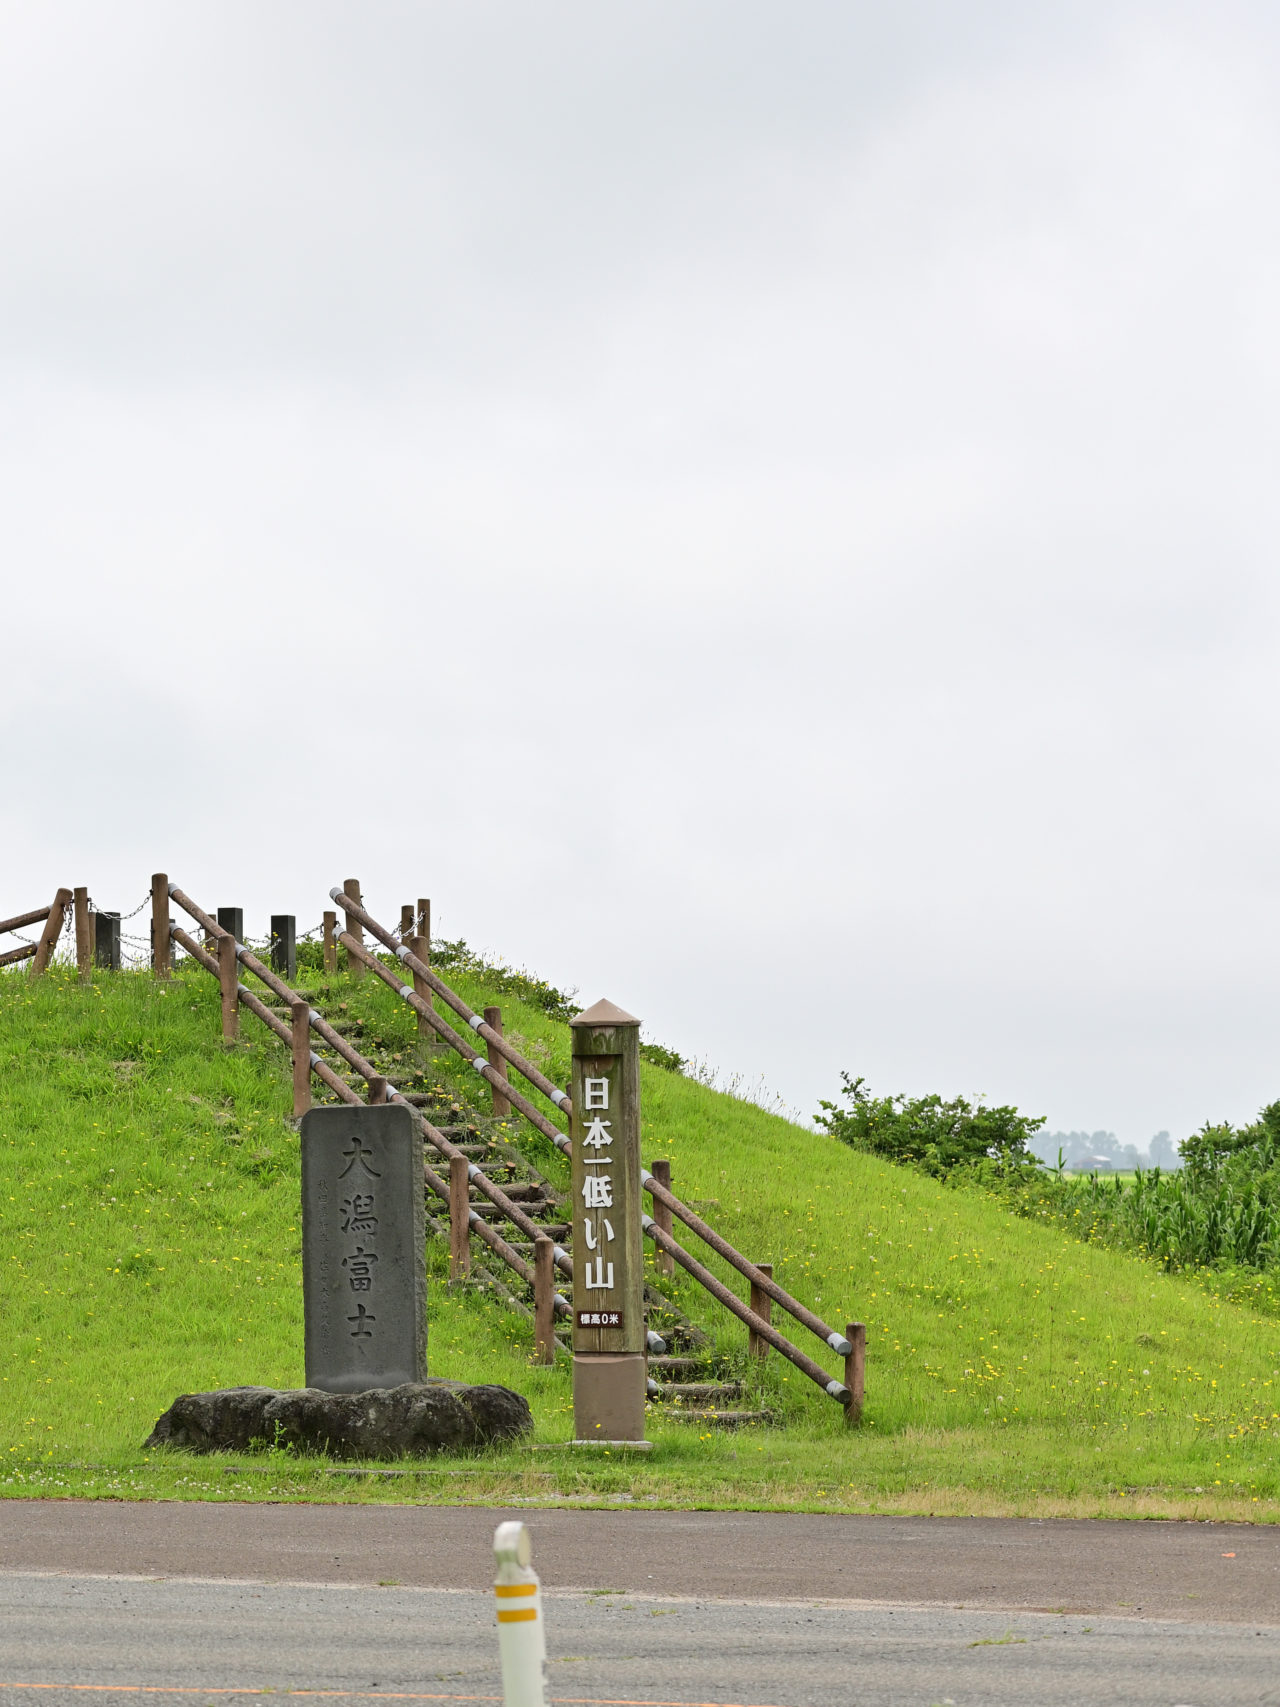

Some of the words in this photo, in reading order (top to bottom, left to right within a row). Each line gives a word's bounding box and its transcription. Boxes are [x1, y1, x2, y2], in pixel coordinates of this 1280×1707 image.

[338, 1136, 382, 1338] 大潟富士
[582, 1077, 615, 1290] 日本一低い山
[580, 1313, 619, 1325] 標高0米
